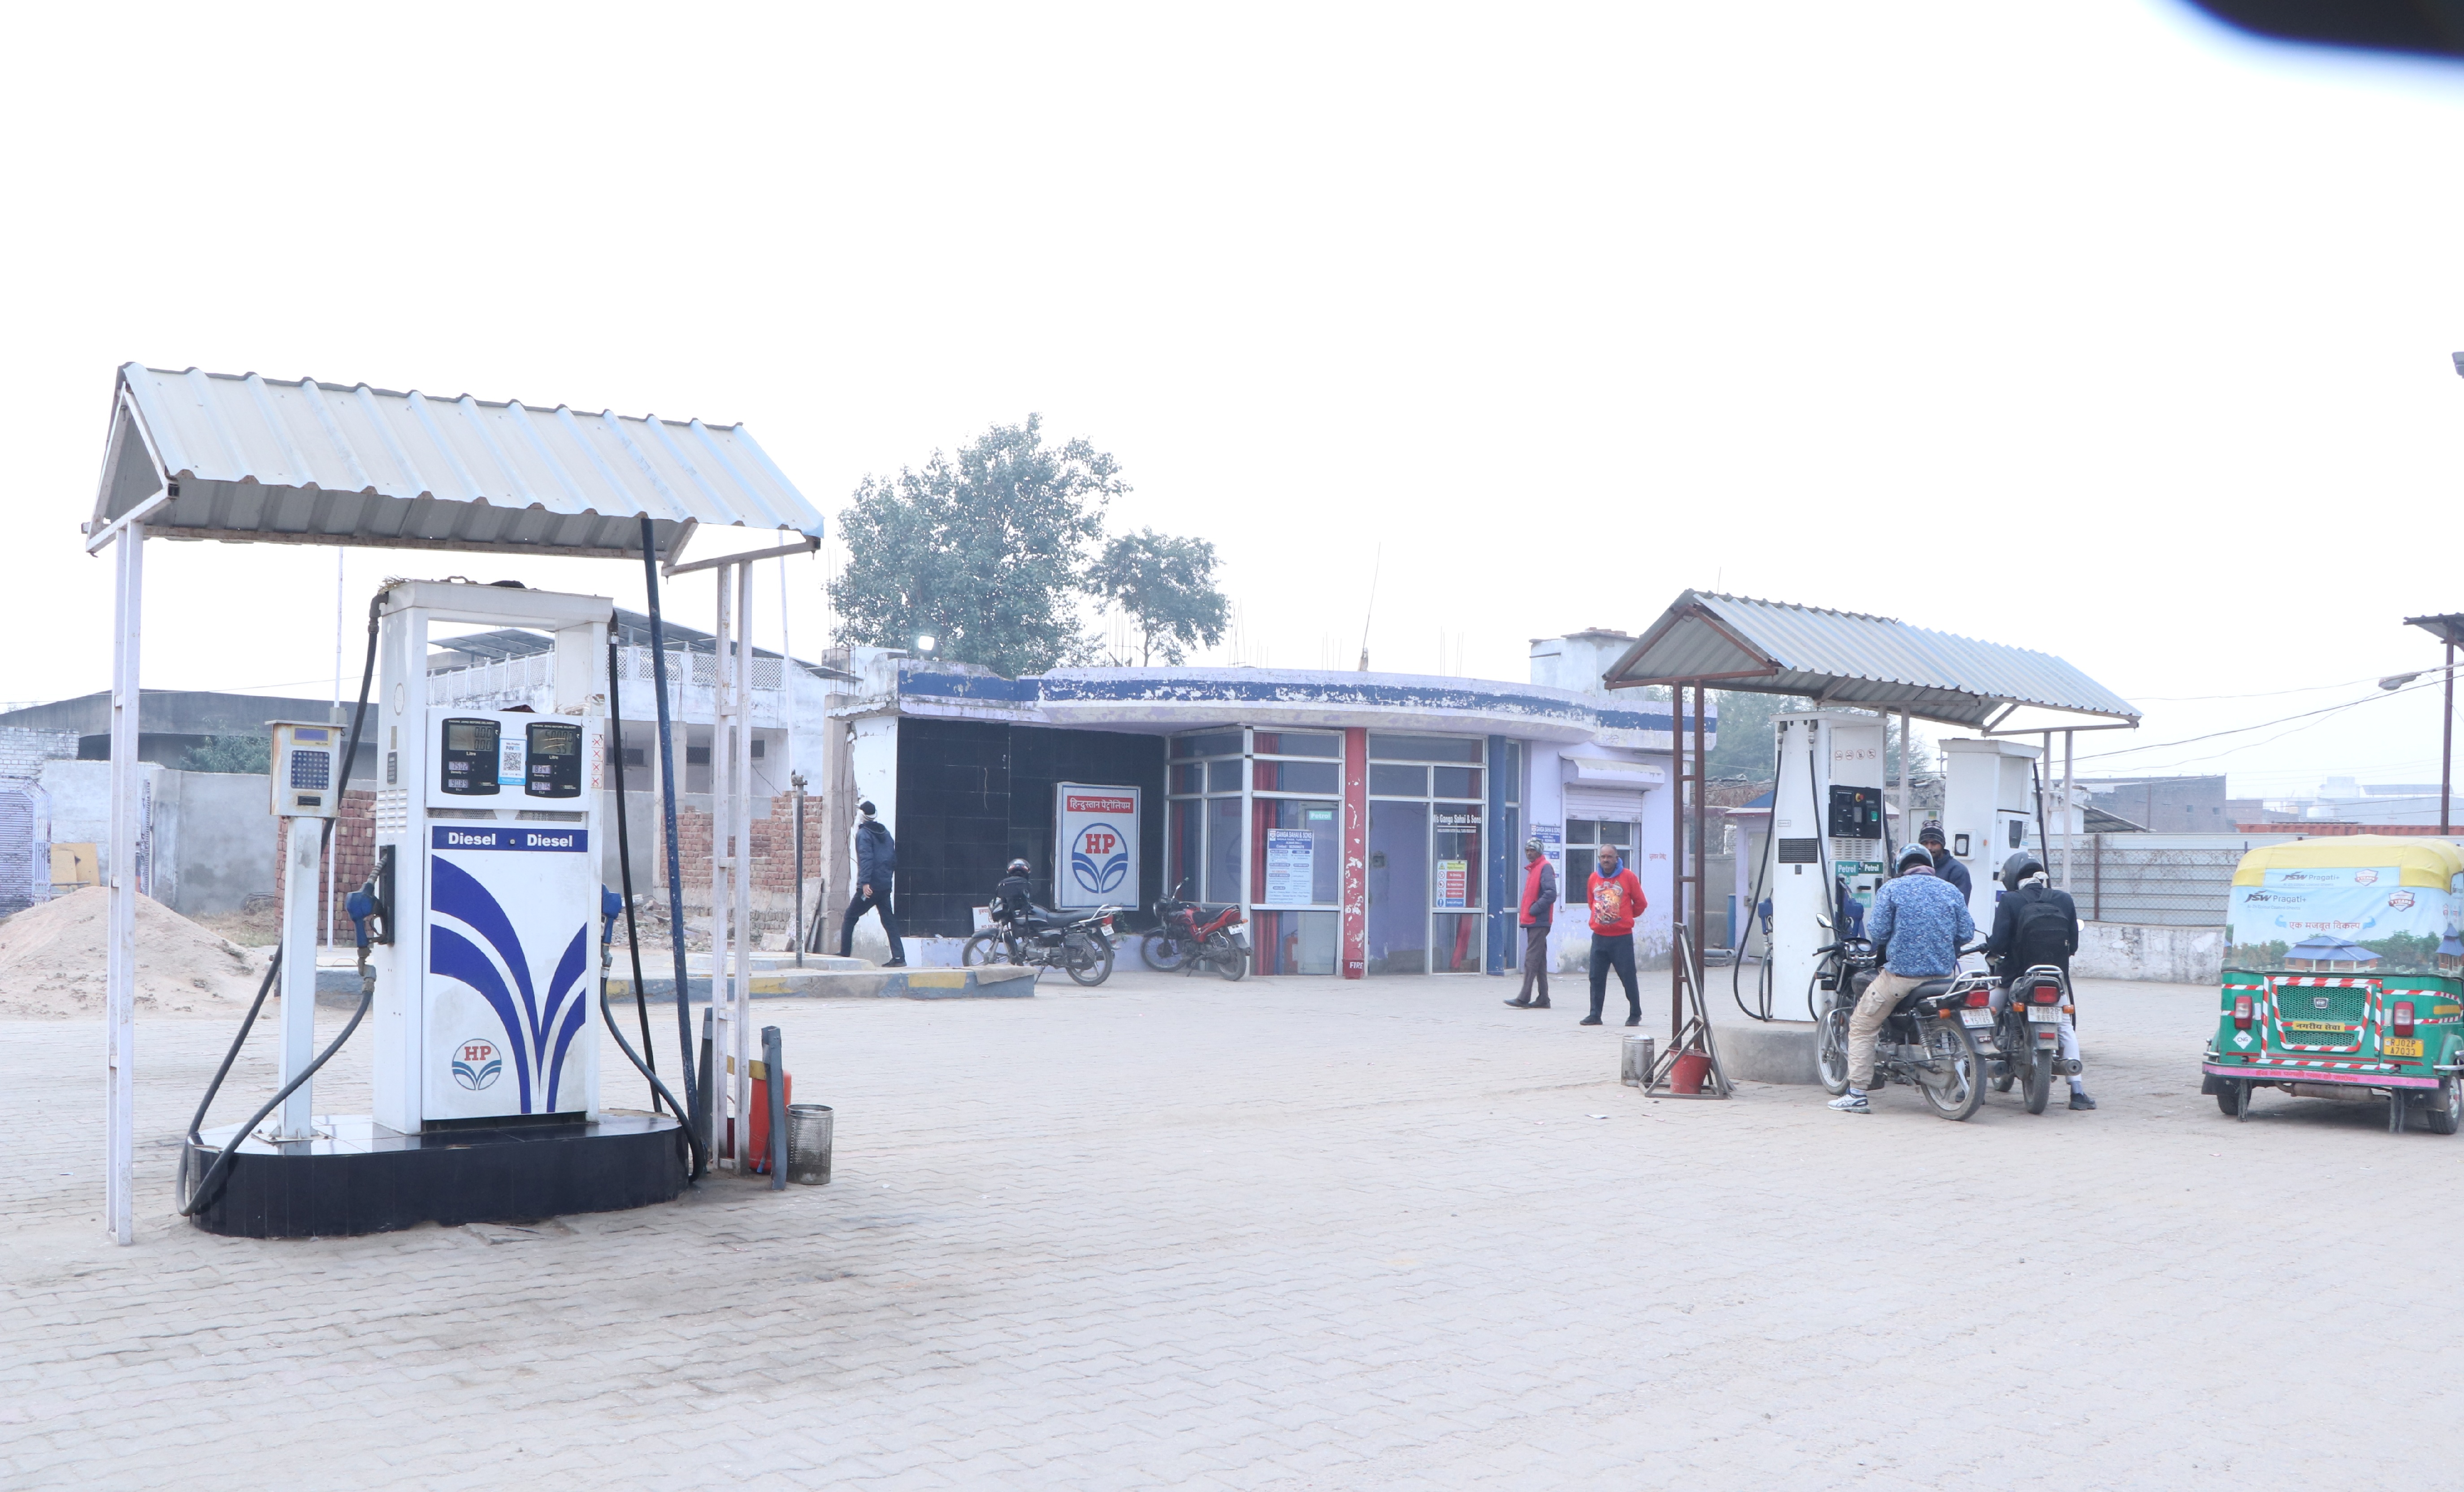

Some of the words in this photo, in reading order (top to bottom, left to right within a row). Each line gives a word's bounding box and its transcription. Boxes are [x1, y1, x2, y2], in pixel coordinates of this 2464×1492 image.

[1070, 798, 1100, 810] हिन्दुस्तान
[1101, 799, 1131, 811] पेट्रोलियम
[1440, 814, 1453, 825] Ganga
[1454, 814, 1466, 823] Sahai
[1466, 815, 1470, 824] &
[1471, 815, 1481, 824] Sons
[448, 832, 496, 845] Diesel
[527, 834, 573, 847] Diesel
[1085, 834, 1115, 854] HP
[1838, 864, 1856, 873] Petrol
[2244, 890, 2272, 902] JSW
[2273, 895, 2306, 903] Pragati+
[2305, 922, 2330, 931] मजबूत
[2333, 920, 2360, 929] विकल्प
[2391, 1039, 2416, 1047] RJ02P
[464, 1046, 491, 1061] HP
[2390, 1047, 2415, 1056] A7033
